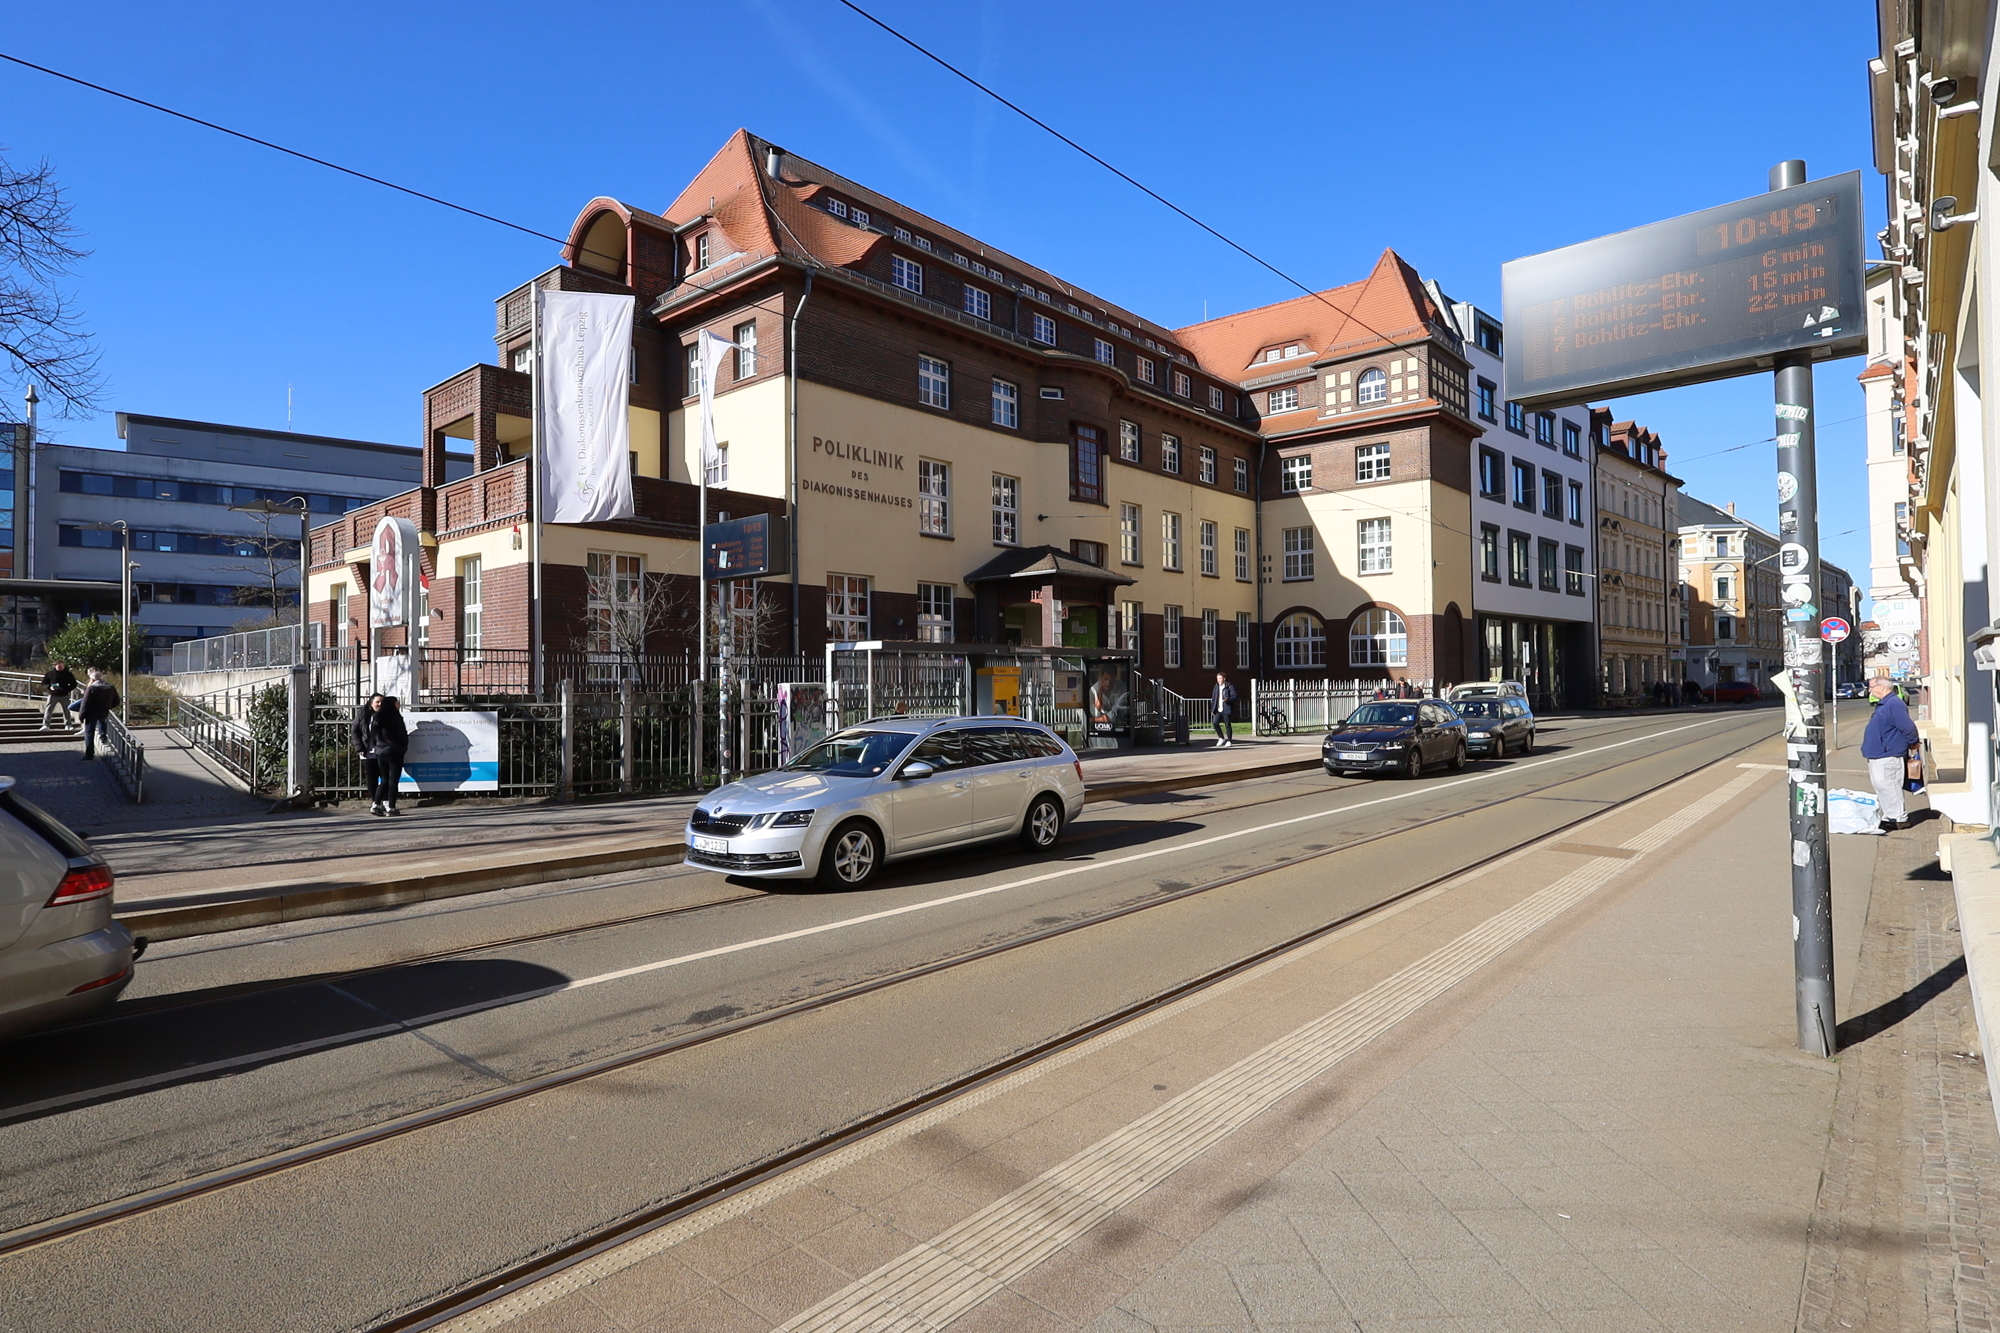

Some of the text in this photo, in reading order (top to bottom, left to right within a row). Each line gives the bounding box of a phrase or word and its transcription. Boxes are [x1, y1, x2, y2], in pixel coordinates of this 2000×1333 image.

[1714, 203, 1817, 249] 10:49
[1762, 250, 1777, 268] 6
[1781, 243, 1824, 264] min
[1748, 270, 1778, 292] 15
[1782, 264, 1825, 286] min
[1748, 292, 1778, 314] 22
[1782, 286, 1826, 306] min
[575, 312, 588, 476] Ev. Diakonissenkrankenhaus Leipzig
[812, 436, 904, 470] POLIKLINIK
[852, 470, 868, 481] DES
[802, 479, 913, 508] DIAKONISSENHAUSES
[744, 522, 761, 533] 10:49
